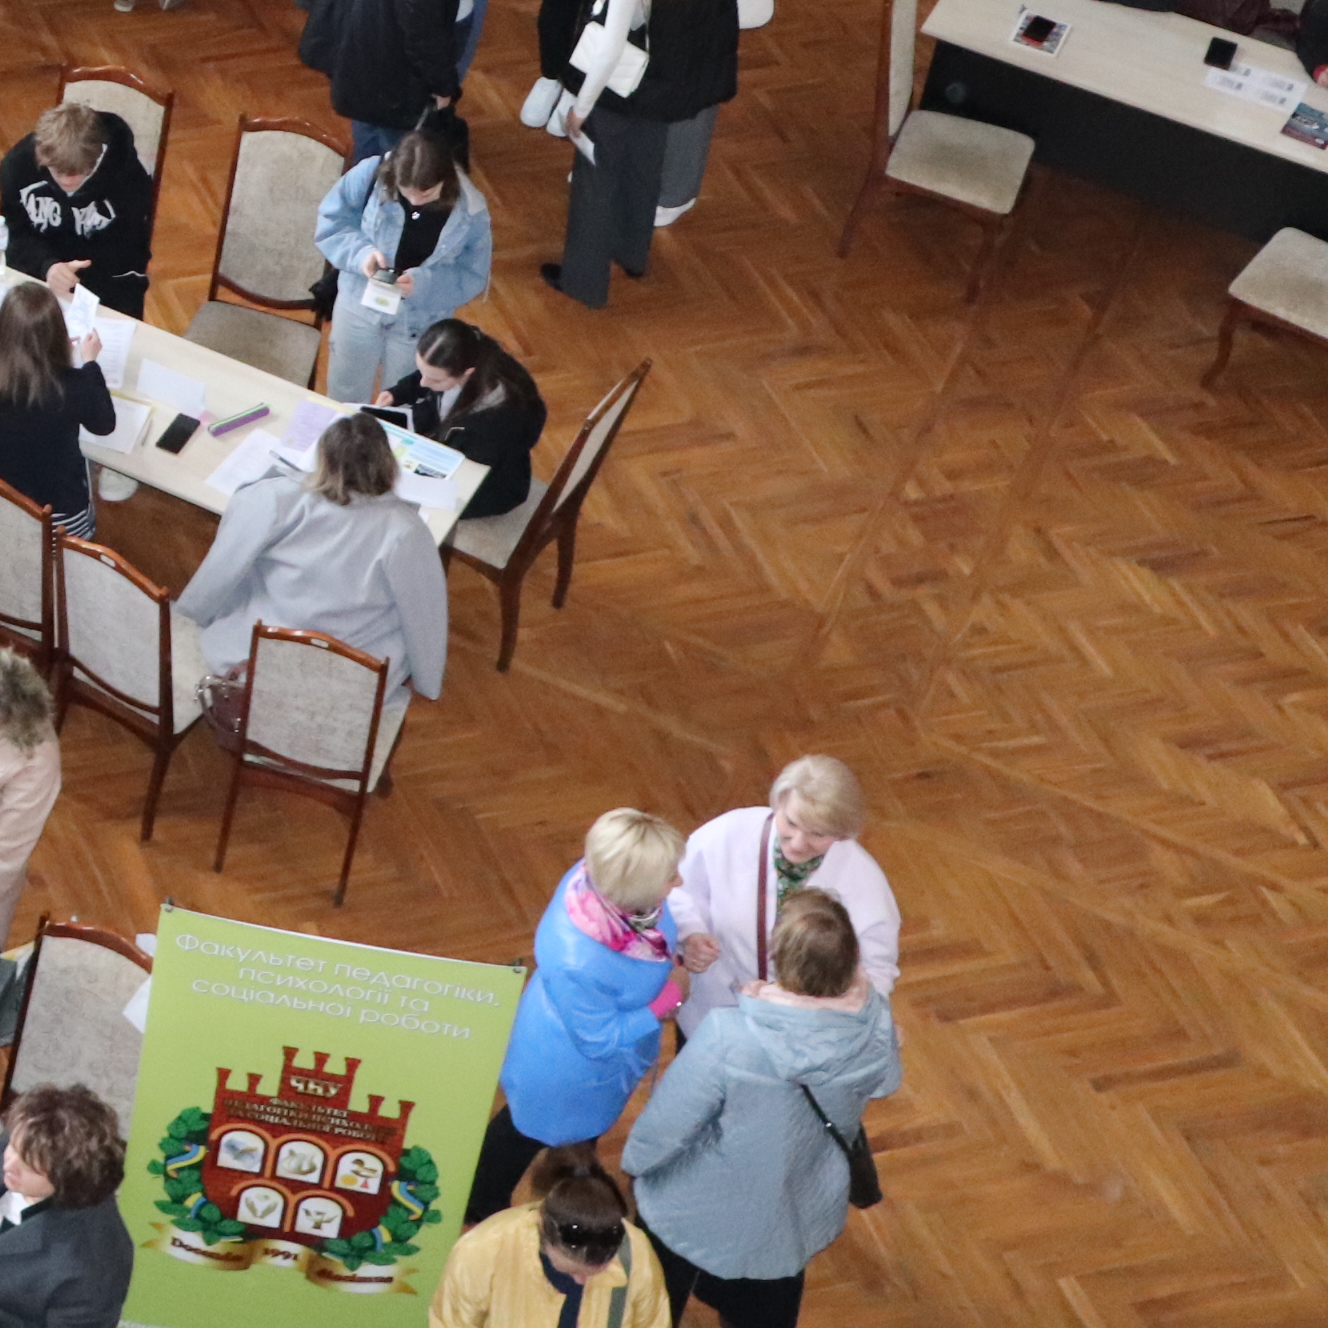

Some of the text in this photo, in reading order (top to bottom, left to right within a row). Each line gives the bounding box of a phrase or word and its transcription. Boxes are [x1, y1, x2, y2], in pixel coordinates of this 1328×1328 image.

[174, 933, 502, 1007] Факультет педагогіки,
[237, 967, 430, 1014] психології та
[191, 978, 472, 1040] соціальної роботи
